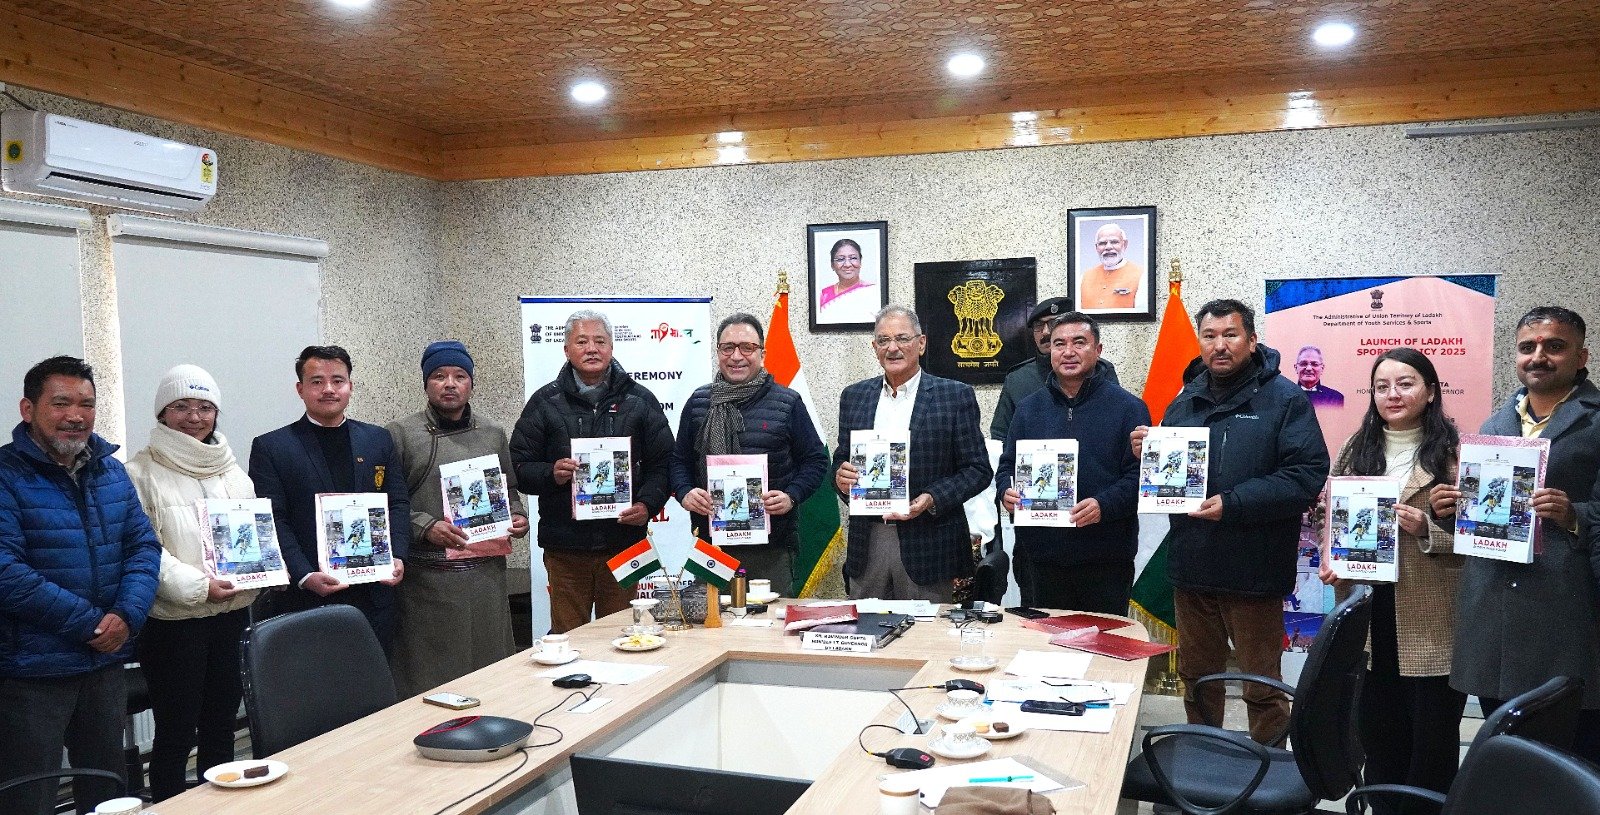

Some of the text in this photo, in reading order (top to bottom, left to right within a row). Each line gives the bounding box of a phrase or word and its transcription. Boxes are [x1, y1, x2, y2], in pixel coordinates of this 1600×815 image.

[1422, 338, 1462, 346] LADAKH
[627, 372, 682, 380] EREMONY
[471, 524, 496, 534] LADAKH
[1474, 538, 1508, 548] LADAKH
